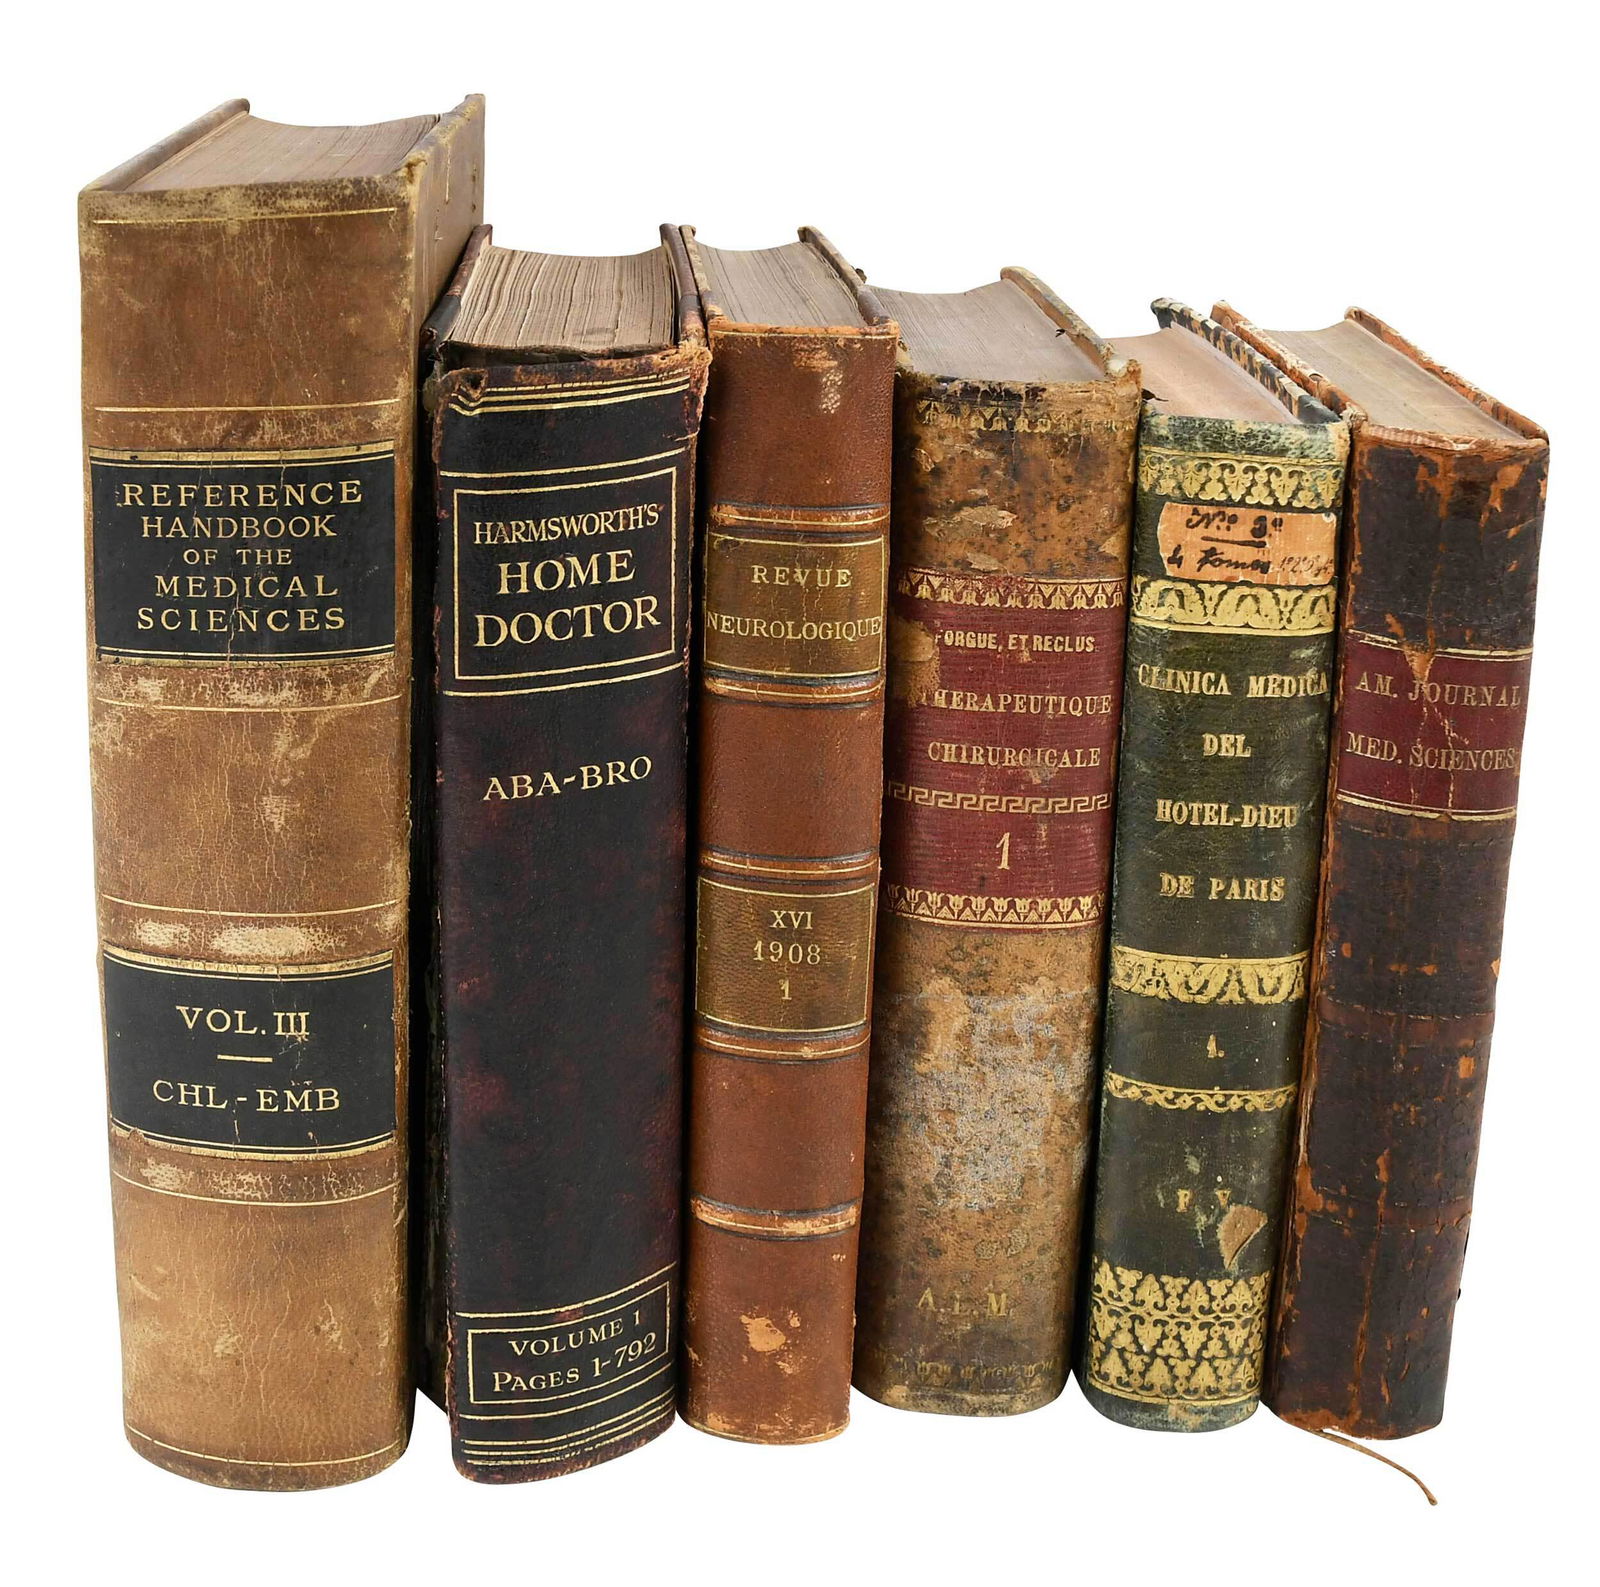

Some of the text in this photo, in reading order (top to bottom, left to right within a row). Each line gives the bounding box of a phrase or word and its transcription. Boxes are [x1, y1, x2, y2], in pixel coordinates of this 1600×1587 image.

[121, 480, 362, 507] REFERENCE
[141, 514, 338, 539] HANDBOOK
[473, 504, 661, 545] HARMSWORTH'S
[183, 548, 293, 566] OF THE
[497, 549, 636, 595] HOME
[155, 575, 339, 599] MEDICAL
[751, 565, 852, 588] REVUE
[137, 607, 346, 633] SCIENCES
[474, 595, 662, 648] DOCTOR
[706, 611, 882, 642] NEUROLOGIQUE
[1008, 634, 1027, 651] ET
[1138, 664, 1328, 698] CLINICA MEDICA
[1355, 671, 1521, 707] AM. JOURNAL
[1202, 733, 1251, 758] DEL
[1345, 731, 1517, 771] MED. SCIENCES
[483, 755, 653, 801] ABA-BRO
[1155, 799, 1298, 829] HOTEL-DIEU
[996, 832, 1011, 870] 1
[1159, 872, 1286, 902] DE PARIS
[769, 910, 813, 930] XVI
[753, 941, 821, 965] 1908
[779, 979, 792, 1000] 1
[176, 1005, 311, 1037] VOL. III
[508, 1318, 624, 1357] VOLUME
[592, 1332, 657, 1378] 1-792
